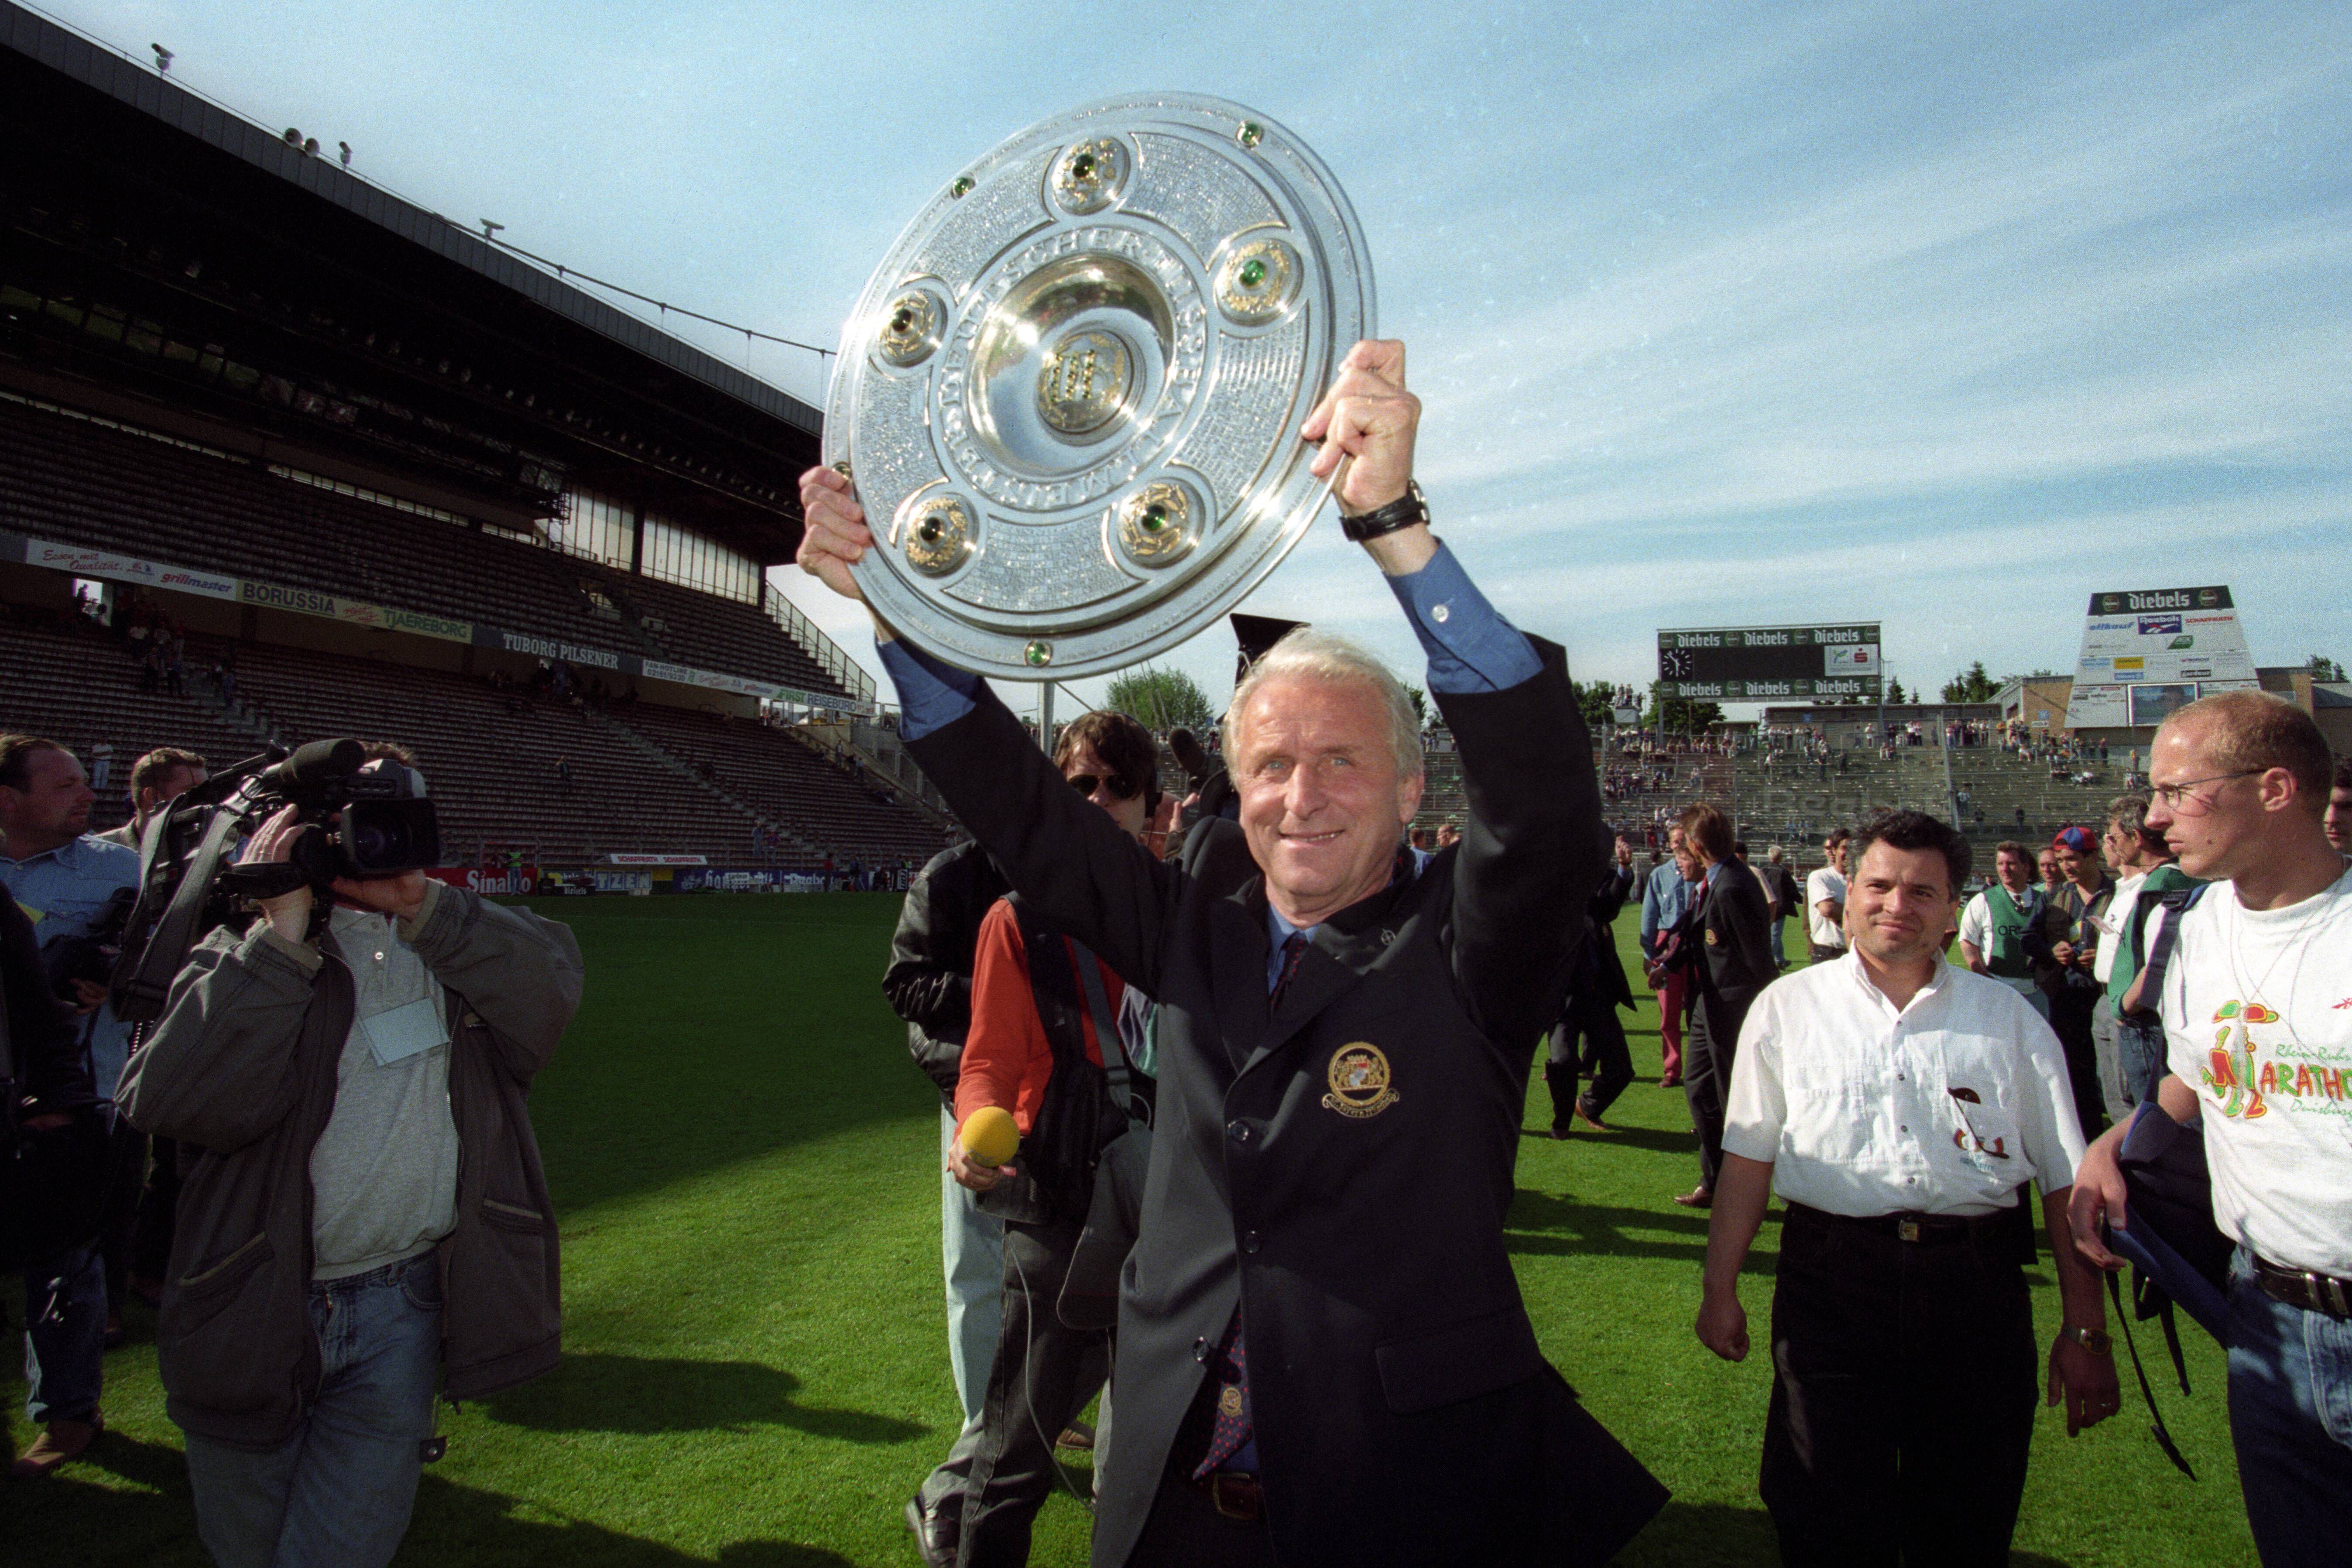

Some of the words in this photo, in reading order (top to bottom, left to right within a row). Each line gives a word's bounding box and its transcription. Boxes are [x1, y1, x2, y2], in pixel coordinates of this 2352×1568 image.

[43, 549, 75, 561] Essen
[160, 573, 232, 592] grillmaster
[243, 582, 335, 613] BORUSSIA
[384, 610, 467, 638] TJAEREBORG
[2139, 615, 2180, 624] Reebok
[504, 633, 556, 658] TUBORG
[560, 645, 619, 669] PILSENER
[645, 661, 687, 674] FAN-HOTLINE
[776, 689, 805, 703] FIRST
[467, 870, 531, 894] Sinalo
